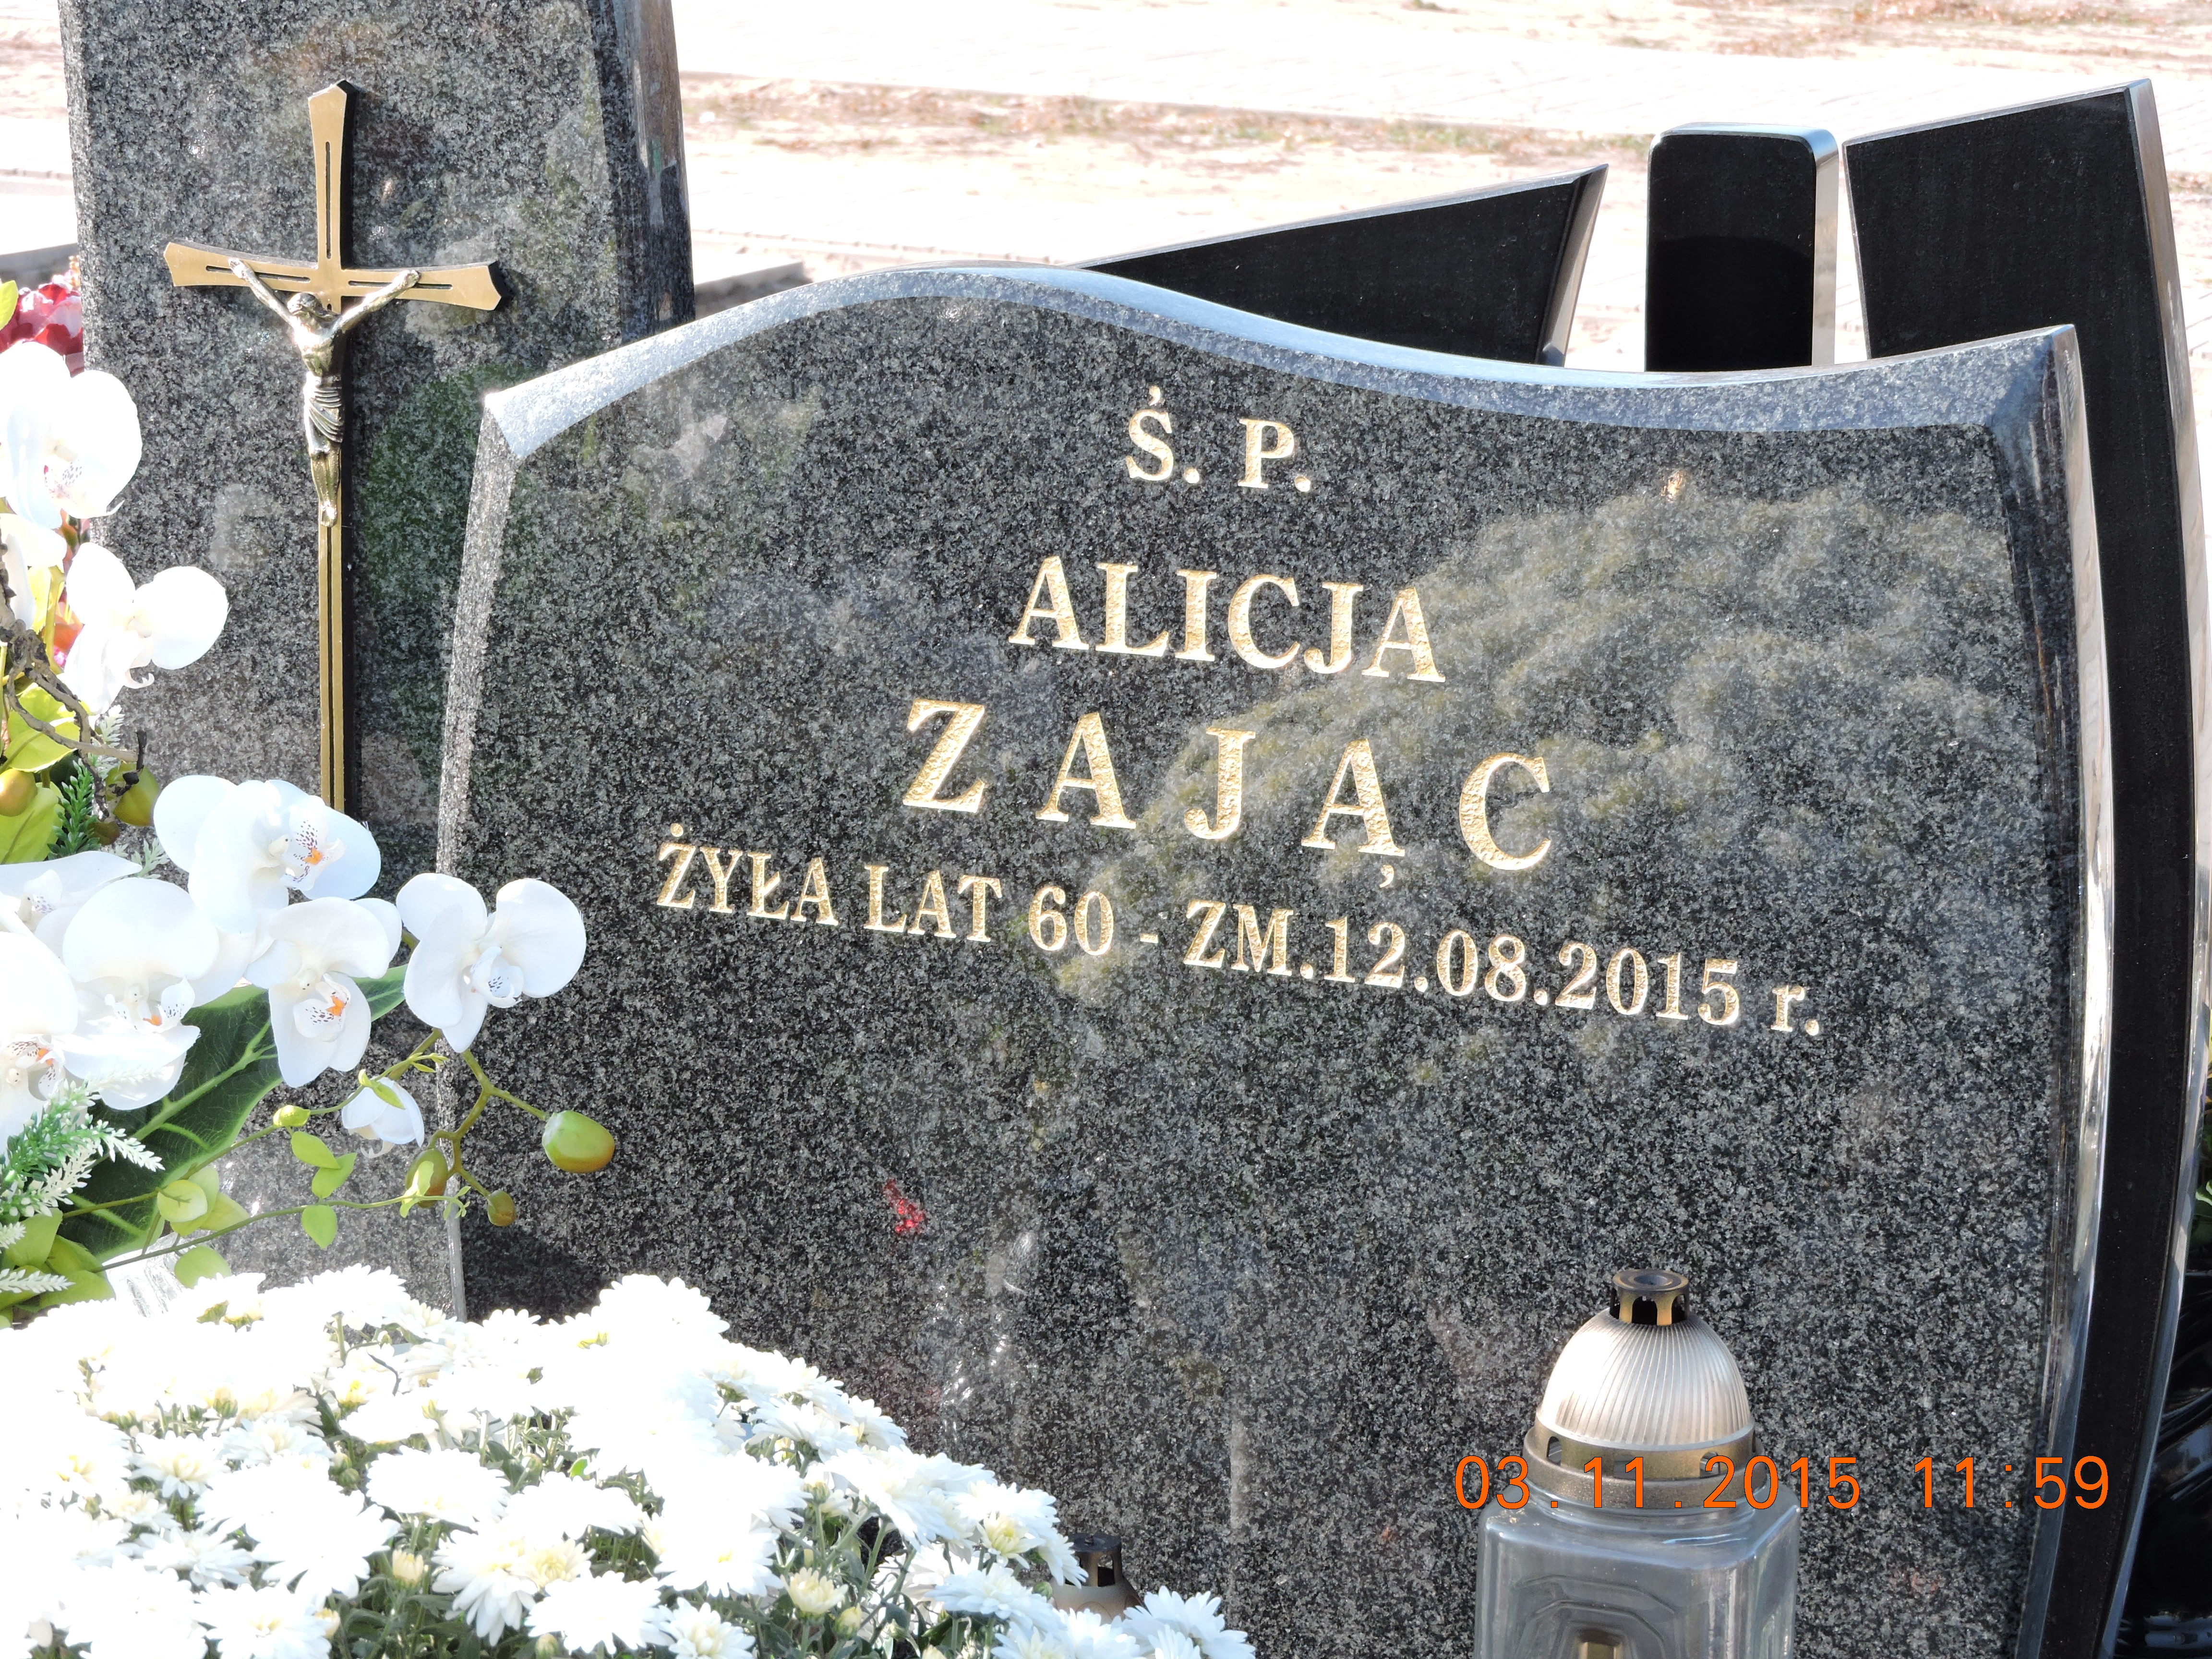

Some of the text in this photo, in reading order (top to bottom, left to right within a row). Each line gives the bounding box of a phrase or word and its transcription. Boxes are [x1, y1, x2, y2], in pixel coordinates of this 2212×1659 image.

[1125, 385, 1311, 493] Ś. P.
[1008, 555, 1446, 683] ALICJA
[656, 823, 839, 926] ŻYŁA
[863, 865, 1003, 943] LAT
[1028, 885, 1115, 959] 60
[1770, 985, 1821, 1036] r.
